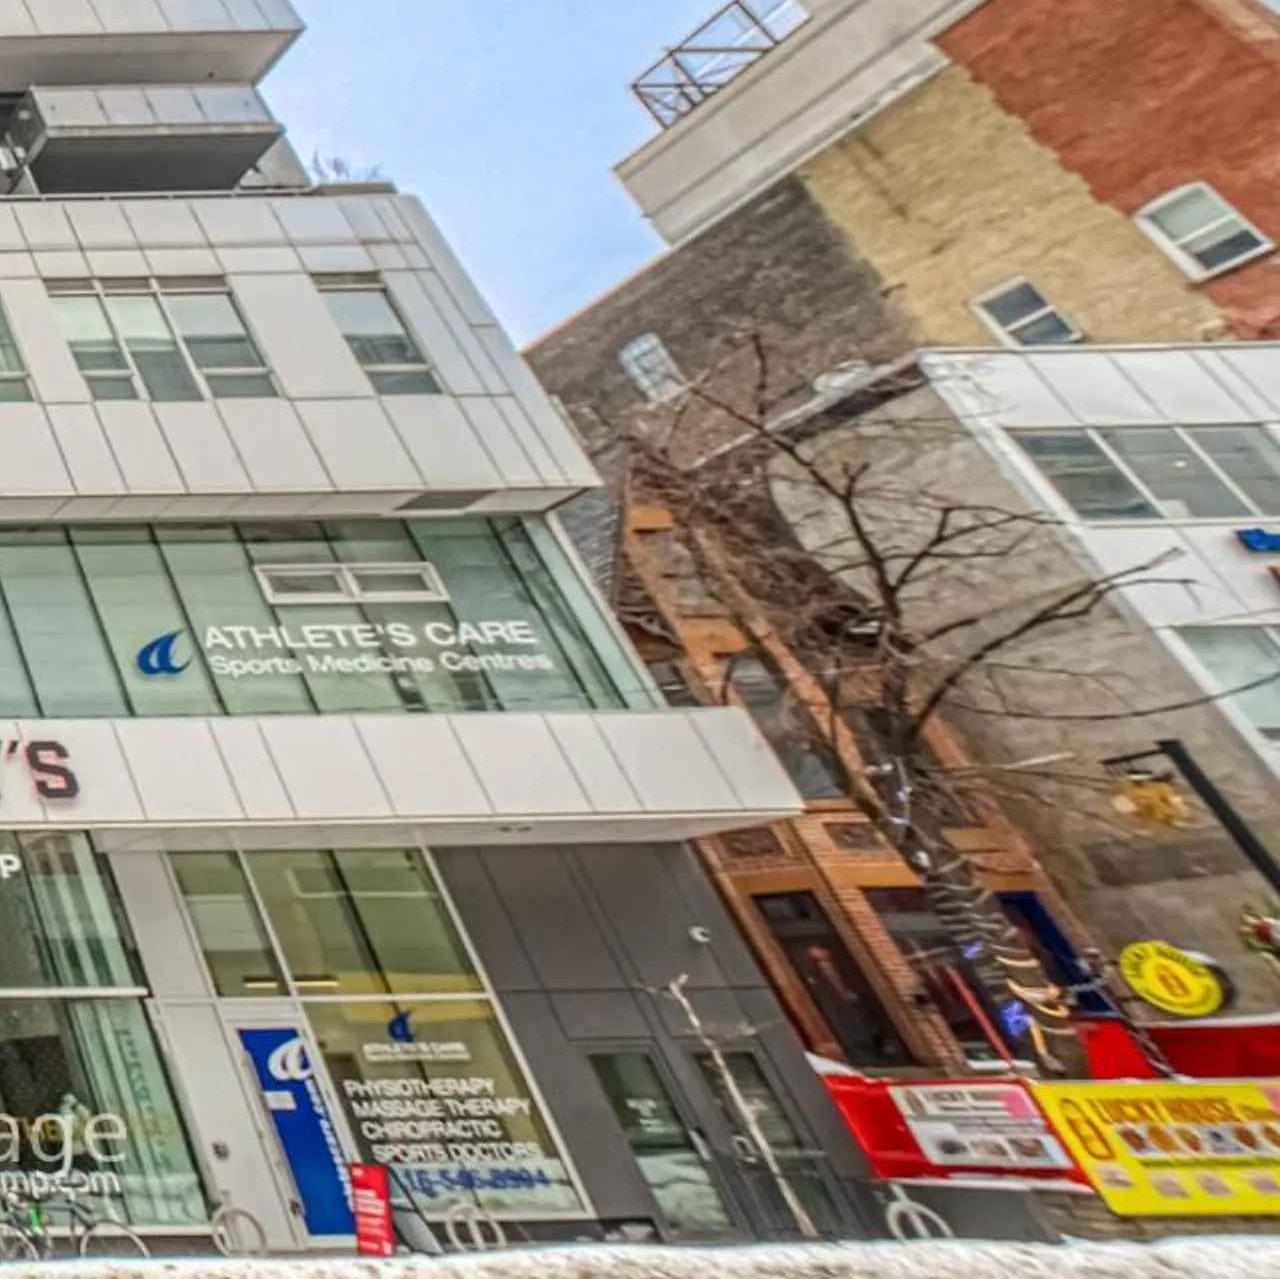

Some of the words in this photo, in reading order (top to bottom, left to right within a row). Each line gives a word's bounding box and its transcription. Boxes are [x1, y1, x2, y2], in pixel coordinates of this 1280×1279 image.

[204, 622, 416, 650] ATHLETE'S
[425, 620, 539, 646] CARE
[209, 655, 303, 677] Sports
[310, 652, 434, 675] Medicine
[442, 650, 553, 671] Centres
[342, 1078, 495, 1097] PHYSIOTHERAPY
[351, 1099, 444, 1118] MASSAGE
[445, 1098, 531, 1117] THERAPY
[361, 1119, 503, 1140] CHIROPRACTIC
[449, 1142, 540, 1162] DOCTORS
